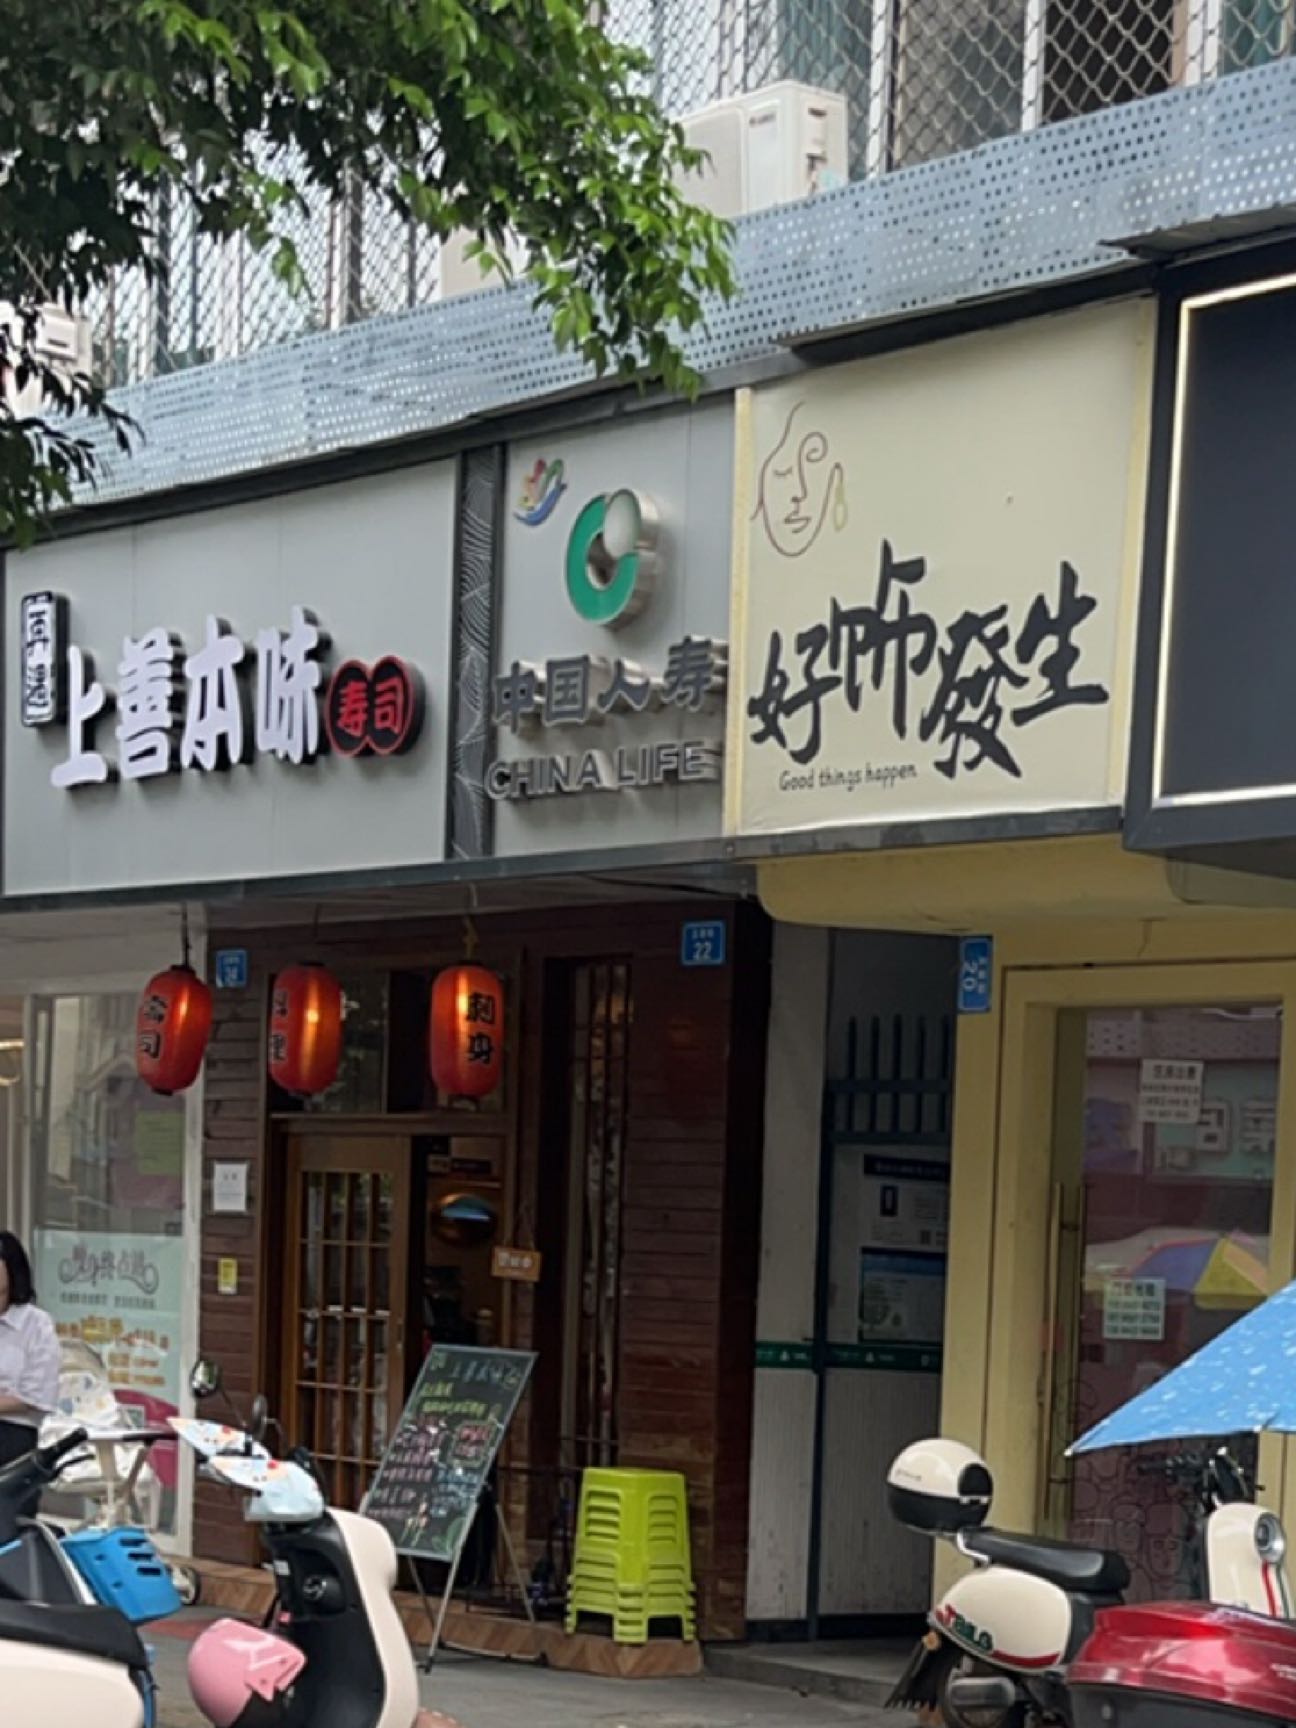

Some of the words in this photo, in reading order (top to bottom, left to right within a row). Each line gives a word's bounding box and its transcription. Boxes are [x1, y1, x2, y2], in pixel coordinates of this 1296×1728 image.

[50, 606, 322, 788] 上善本味
[335, 674, 403, 738] 寿司
[494, 637, 713, 734] 中国人寿
[485, 750, 604, 800] CHINA
[617, 742, 713, 787] LIFE
[779, 768, 815, 791] Good
[819, 765, 862, 793] things
[865, 761, 918, 790] happen
